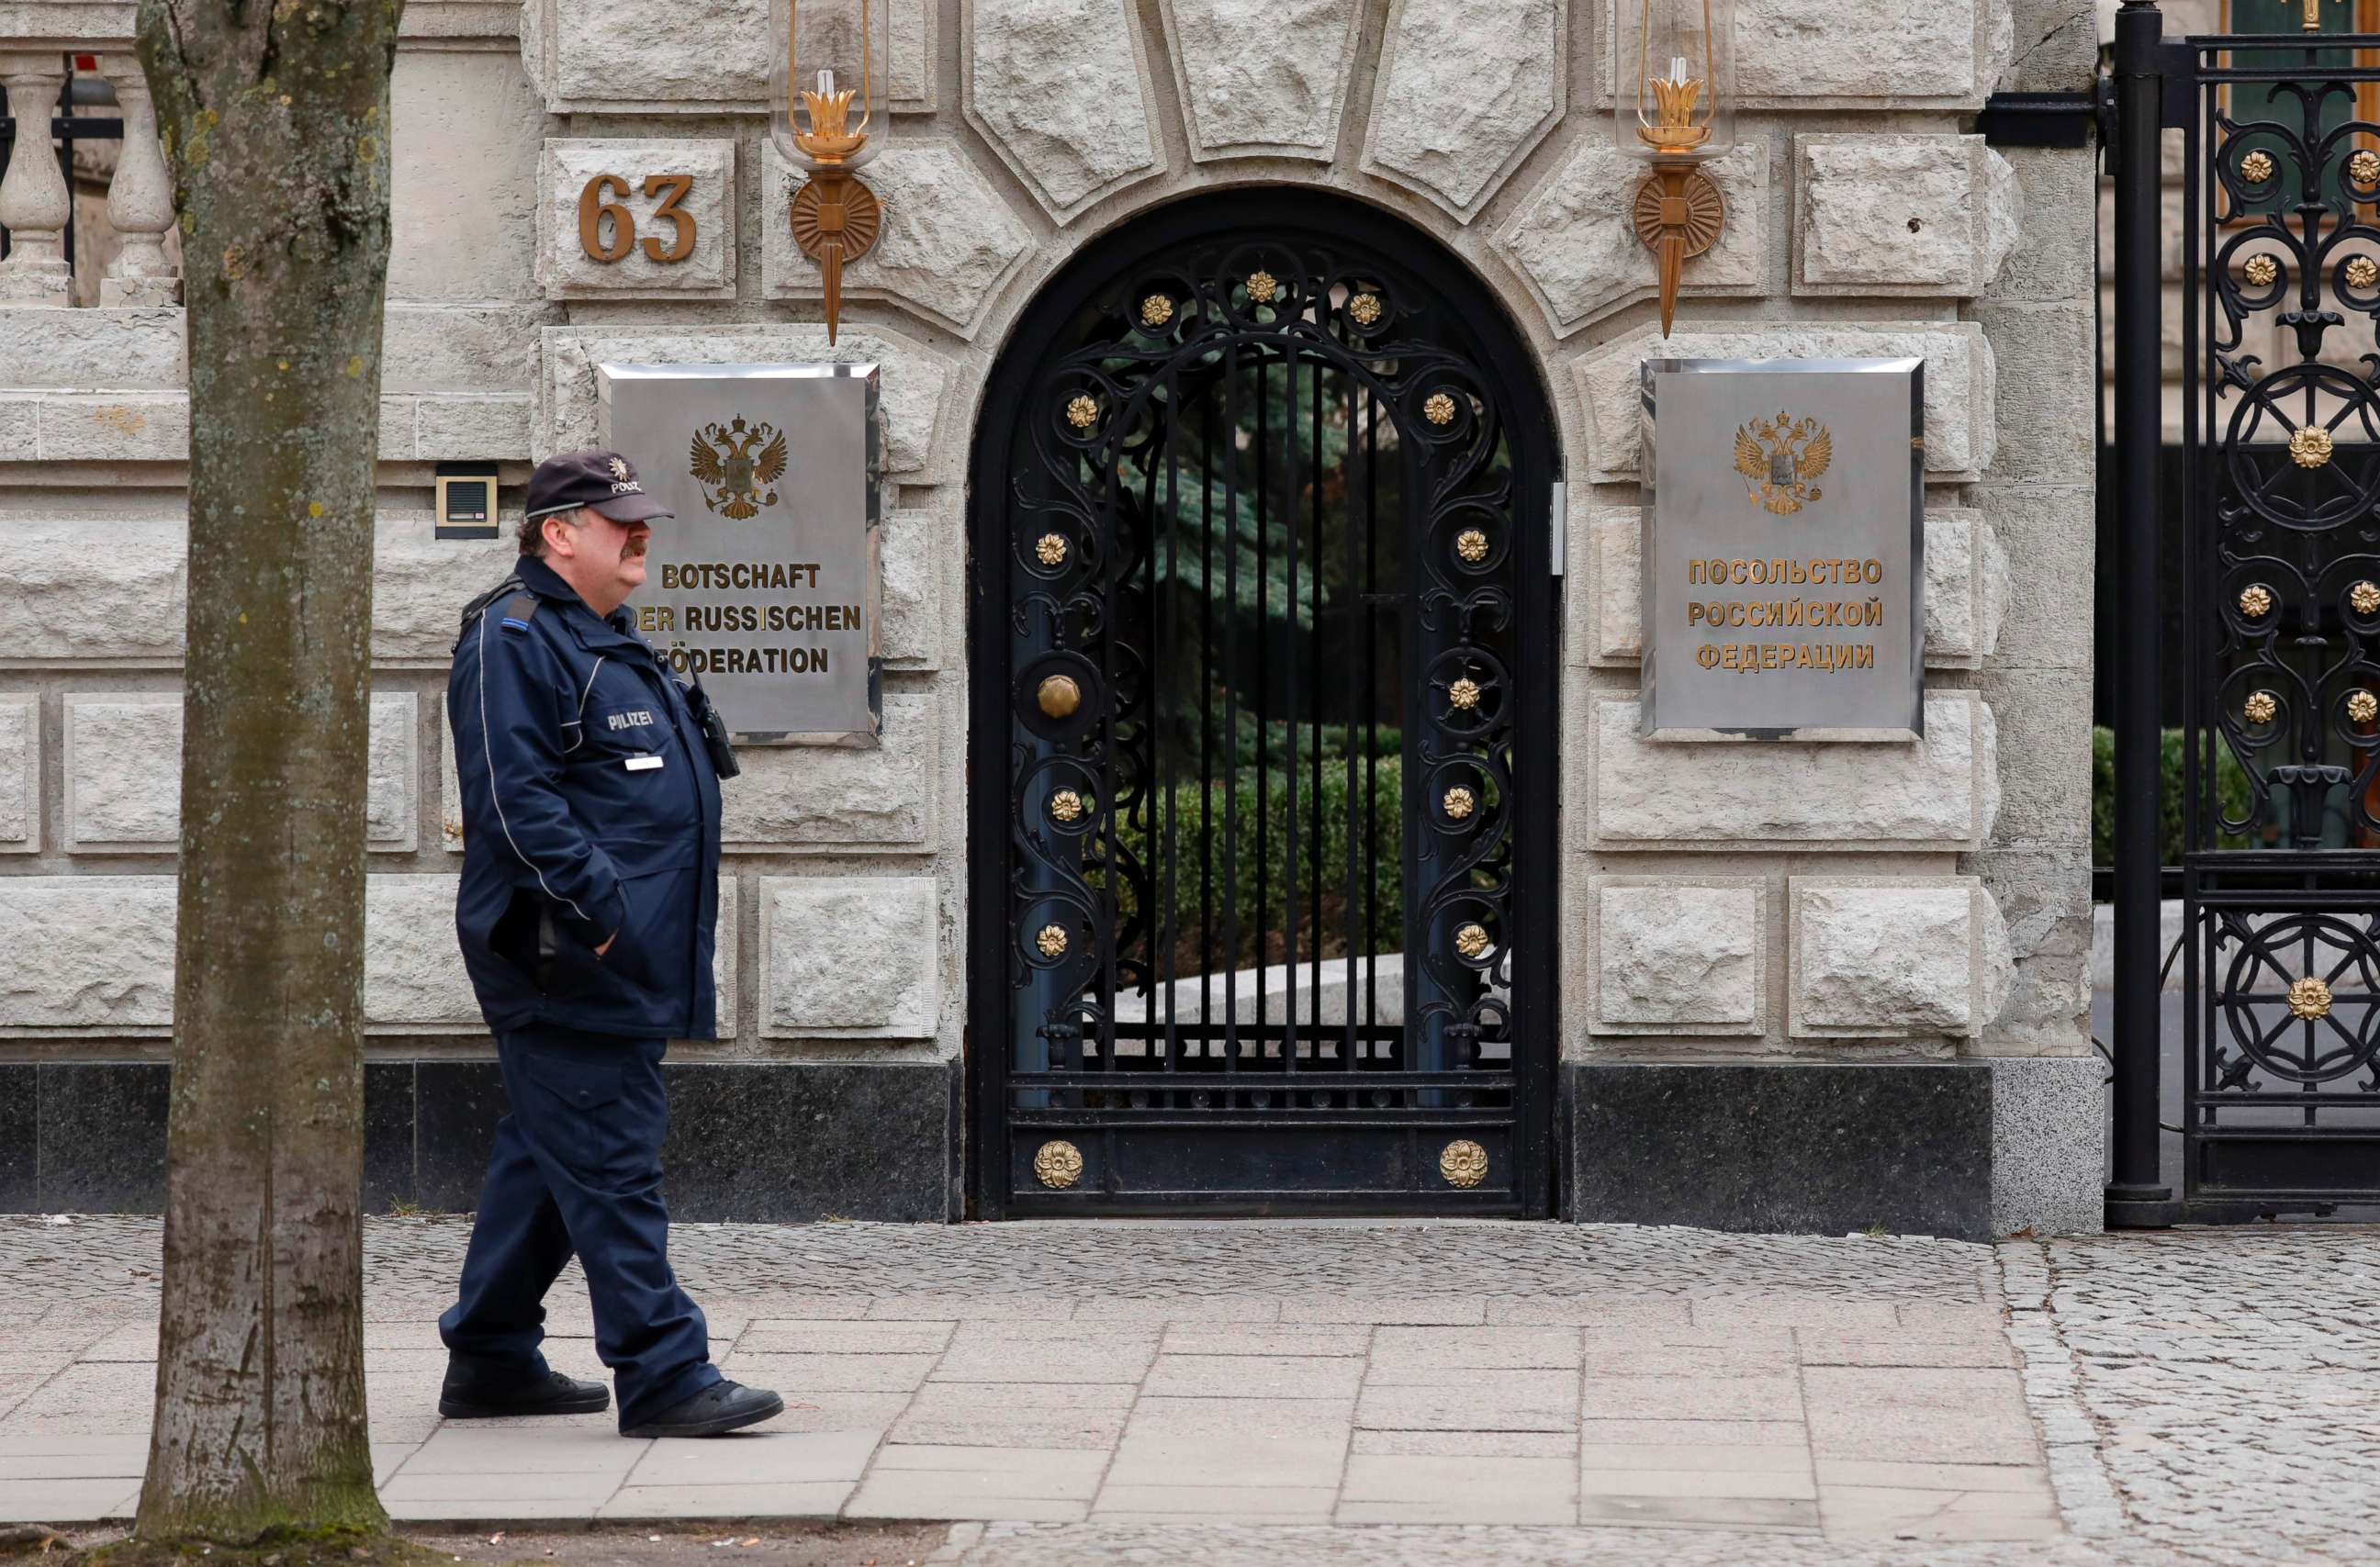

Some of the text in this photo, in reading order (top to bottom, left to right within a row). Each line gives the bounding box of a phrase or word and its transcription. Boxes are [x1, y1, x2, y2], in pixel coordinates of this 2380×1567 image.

[578, 173, 697, 263] 63
[611, 481, 642, 494] POLIZ
[661, 563, 821, 589] BOTSCHAFT
[1689, 557, 1882, 585] ПОСОЛЬСТВО
[632, 605, 861, 632] ER RUSSISCHEN
[1688, 596, 1882, 627] РОССИЙСКОЙ
[1695, 644, 1874, 674] ФЕДЕРАЦИИ
